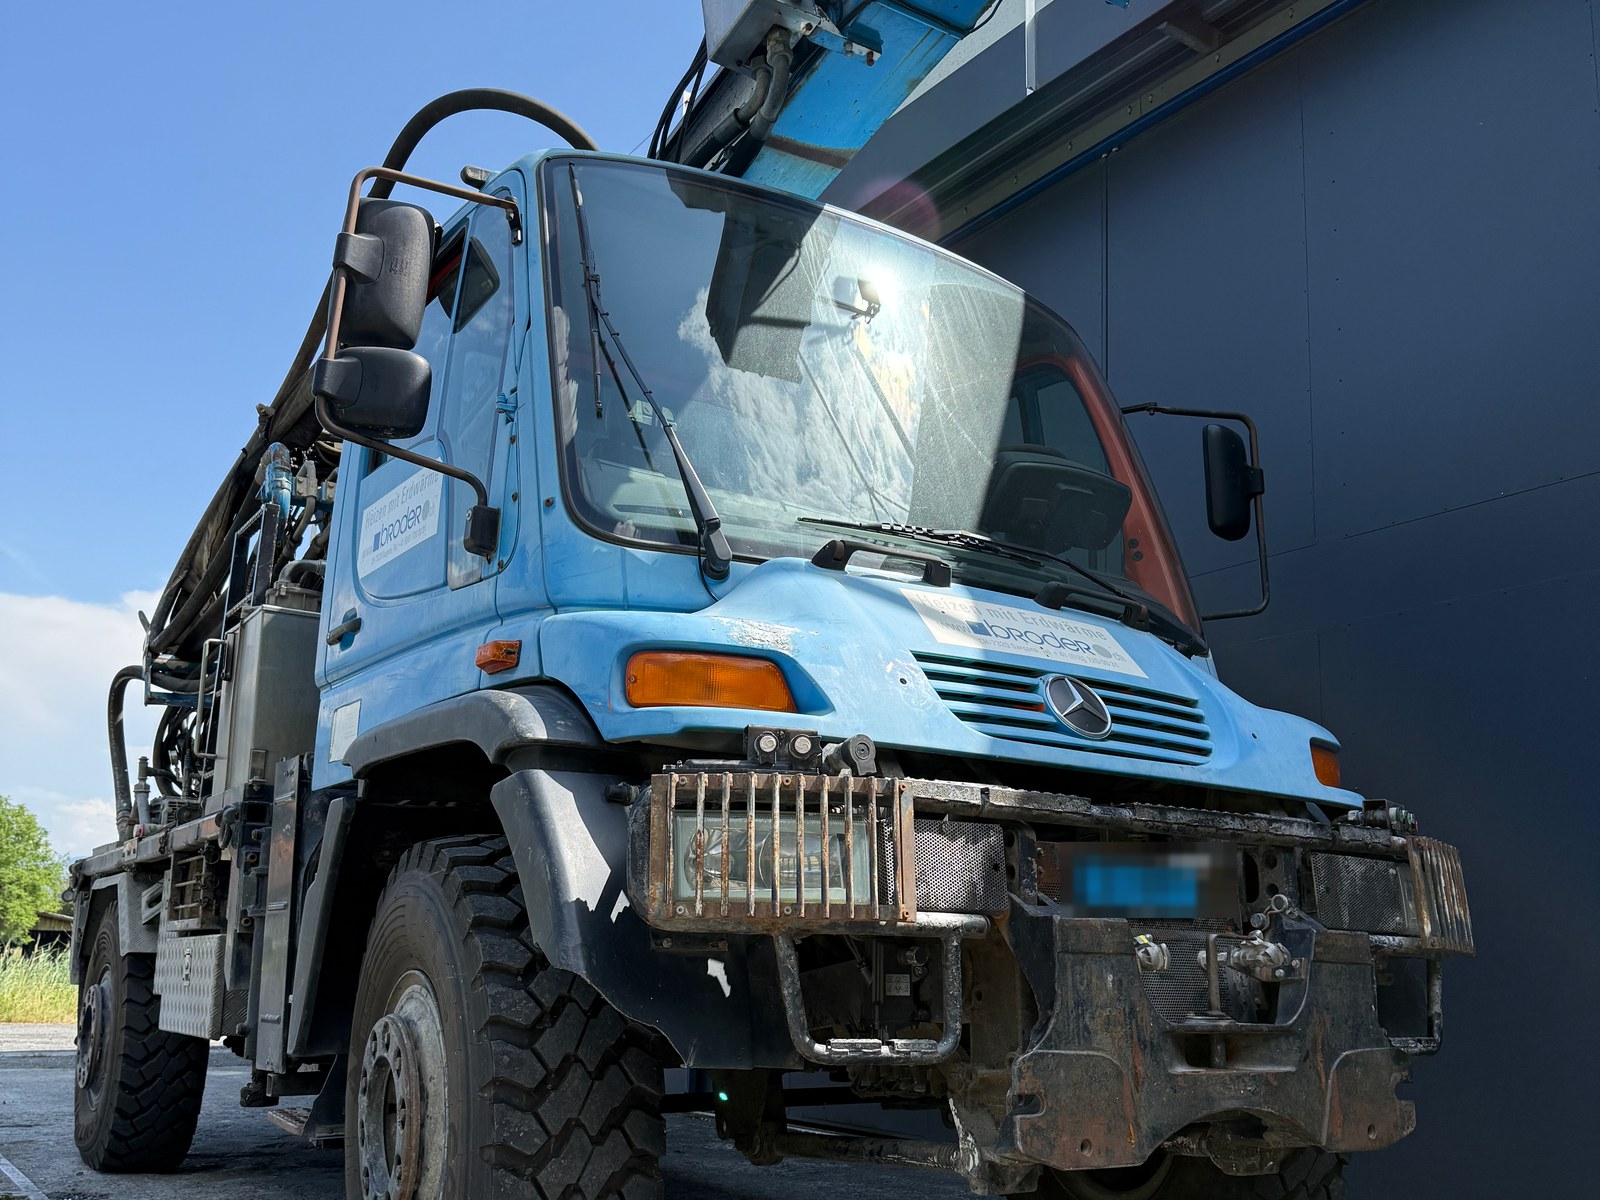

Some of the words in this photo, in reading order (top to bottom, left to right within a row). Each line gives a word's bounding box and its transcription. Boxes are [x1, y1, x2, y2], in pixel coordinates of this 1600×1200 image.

[916, 593, 982, 616] Heizen
[986, 607, 1018, 622] mit
[1018, 611, 1107, 640] Erdwärme
